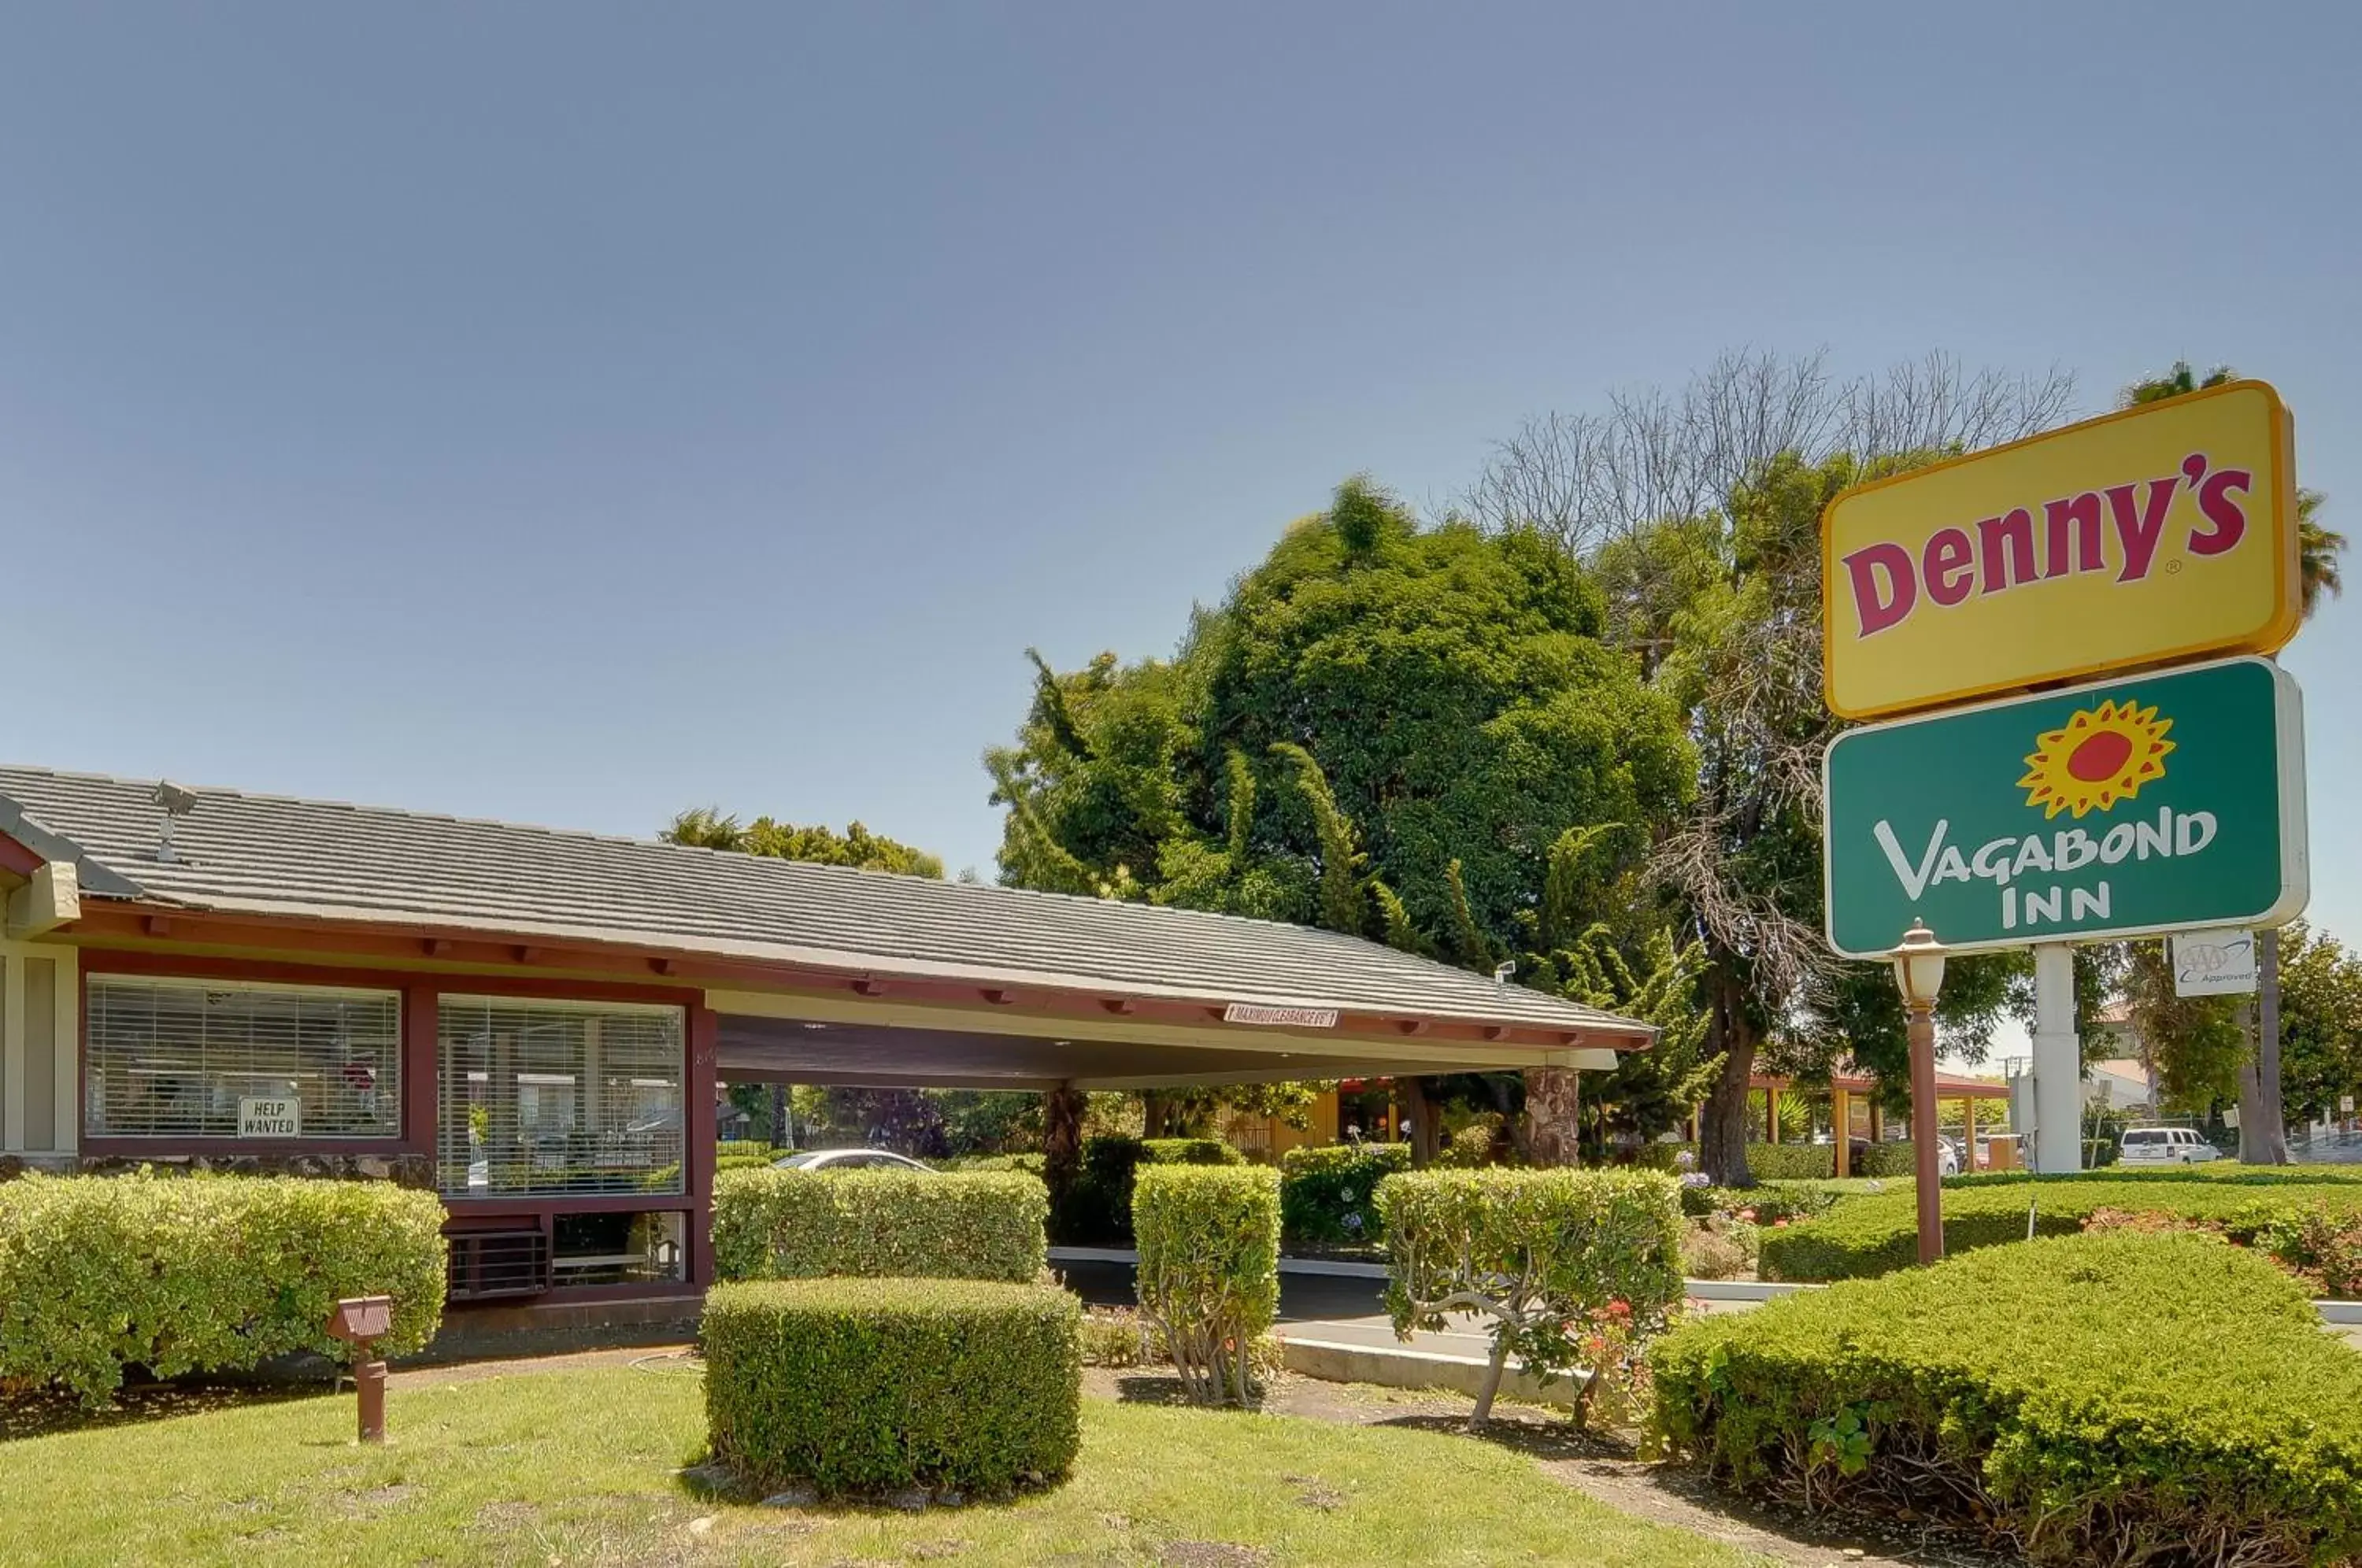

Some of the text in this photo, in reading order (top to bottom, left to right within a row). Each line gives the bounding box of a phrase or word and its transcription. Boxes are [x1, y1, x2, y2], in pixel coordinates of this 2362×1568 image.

[1841, 452, 2252, 639] Denny's
[1873, 806, 2218, 901] VAGABOND
[2002, 881, 2111, 930] INN
[2201, 971, 2253, 983] Approved
[254, 1102, 286, 1116] HELP
[245, 1119, 294, 1133] WANTED
